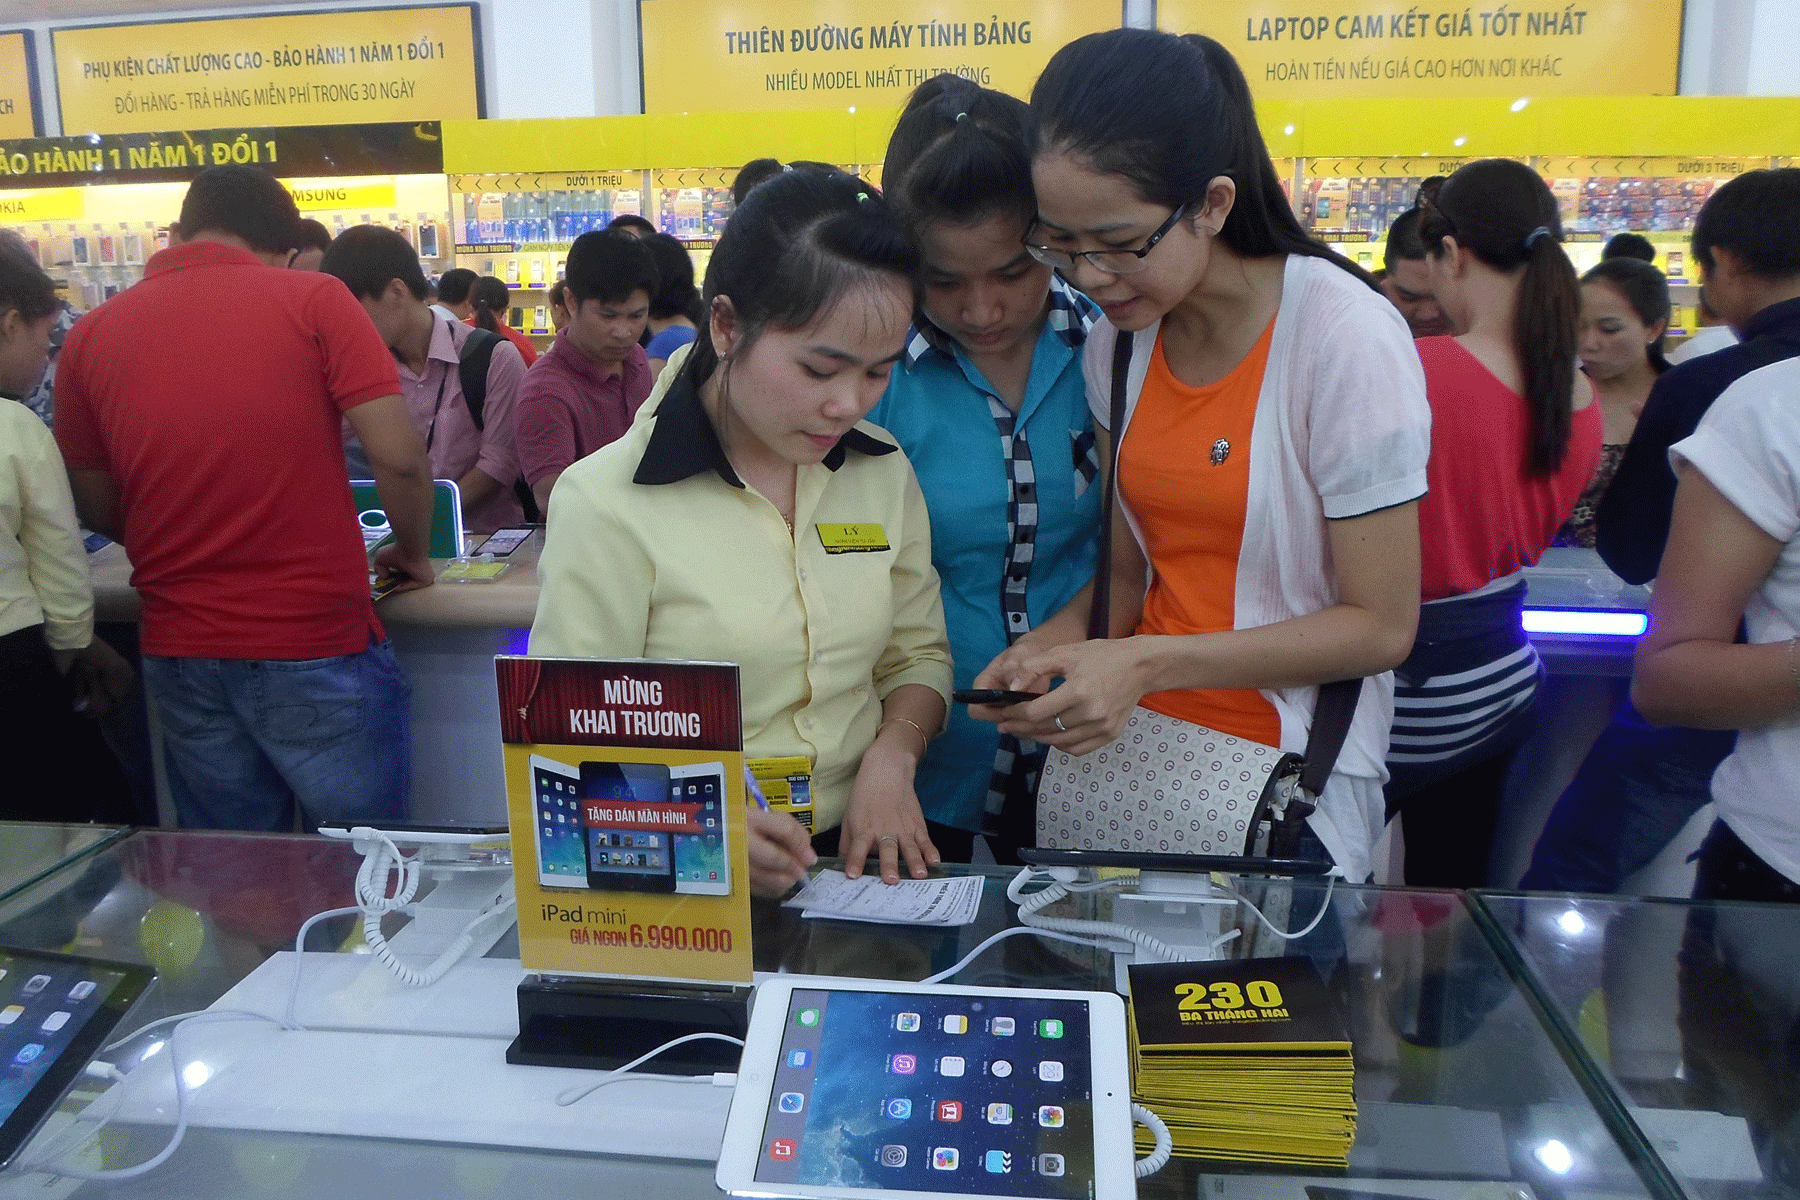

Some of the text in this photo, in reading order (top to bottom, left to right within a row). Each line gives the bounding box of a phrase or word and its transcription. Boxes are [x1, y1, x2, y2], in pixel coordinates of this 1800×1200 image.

[726, 15, 1031, 54] THIÊN ĐƯỜNG MÁY TÍNH BẢNG
[1247, 3, 1587, 41] LAPTOP CAM KẾT GIÁ TỐT NHẤT
[83, 62, 111, 83] PHỤ
[114, 57, 143, 81] KIỆN
[147, 51, 180, 75] CHẤT
[183, 53, 230, 76] LƯỢNG
[234, 51, 262, 70] CAO
[273, 45, 301, 67] BẢO
[306, 44, 346, 66] HÀNH
[349, 46, 356, 63] 1
[360, 42, 393, 63] NĂM
[397, 44, 403, 61] 1
[407, 36, 434, 60] ĐỔI
[438, 42, 444, 59] 1
[1266, 57, 1309, 81] HOÀN
[1350, 54, 1380, 80] NẾU
[1385, 55, 1411, 79] GIÁ
[1414, 57, 1447, 79] CAO
[1450, 56, 1485, 79] HƠN
[1489, 56, 1517, 78] NƠI
[1520, 54, 1562, 79] KHÁC
[766, 67, 808, 91] NHIỀU
[813, 70, 861, 90] MODEL
[865, 64, 902, 88] NHẤT
[115, 93, 137, 114] ĐỔI
[141, 91, 177, 113] HÀNG
[187, 88, 210, 109] TRẢ
[214, 88, 250, 109] HÀNG
[254, 82, 286, 106] MIỄN
[289, 82, 310, 104] PHÍ
[313, 83, 358, 104] TRONG
[362, 83, 377, 101] 30
[380, 78, 416, 99] NGÀY
[34, 147, 103, 174] HÀNH
[109, 151, 122, 170] 1
[129, 141, 188, 170] NĂM
[194, 145, 205, 166] 1
[212, 133, 259, 165] ĐỔI
[266, 140, 277, 163] 1
[566, 174, 623, 188] DƯỚI 1 TRIỆU
[0, 201, 26, 214] KIA
[292, 188, 347, 202] MSUNG
[603, 675, 663, 706] MỪNG
[570, 709, 701, 737] KHAI TRƯƠNG
[587, 805, 687, 824] TẶNG DÁN MÀN HÌNH
[541, 904, 626, 925] iPad mini
[570, 923, 733, 954] GIÁ NGON 6.990.000
[1174, 981, 1283, 1010] 230
[1179, 1008, 1289, 1021] BA THÁNG HAI
[1043, 1064, 1056, 1079] 29
